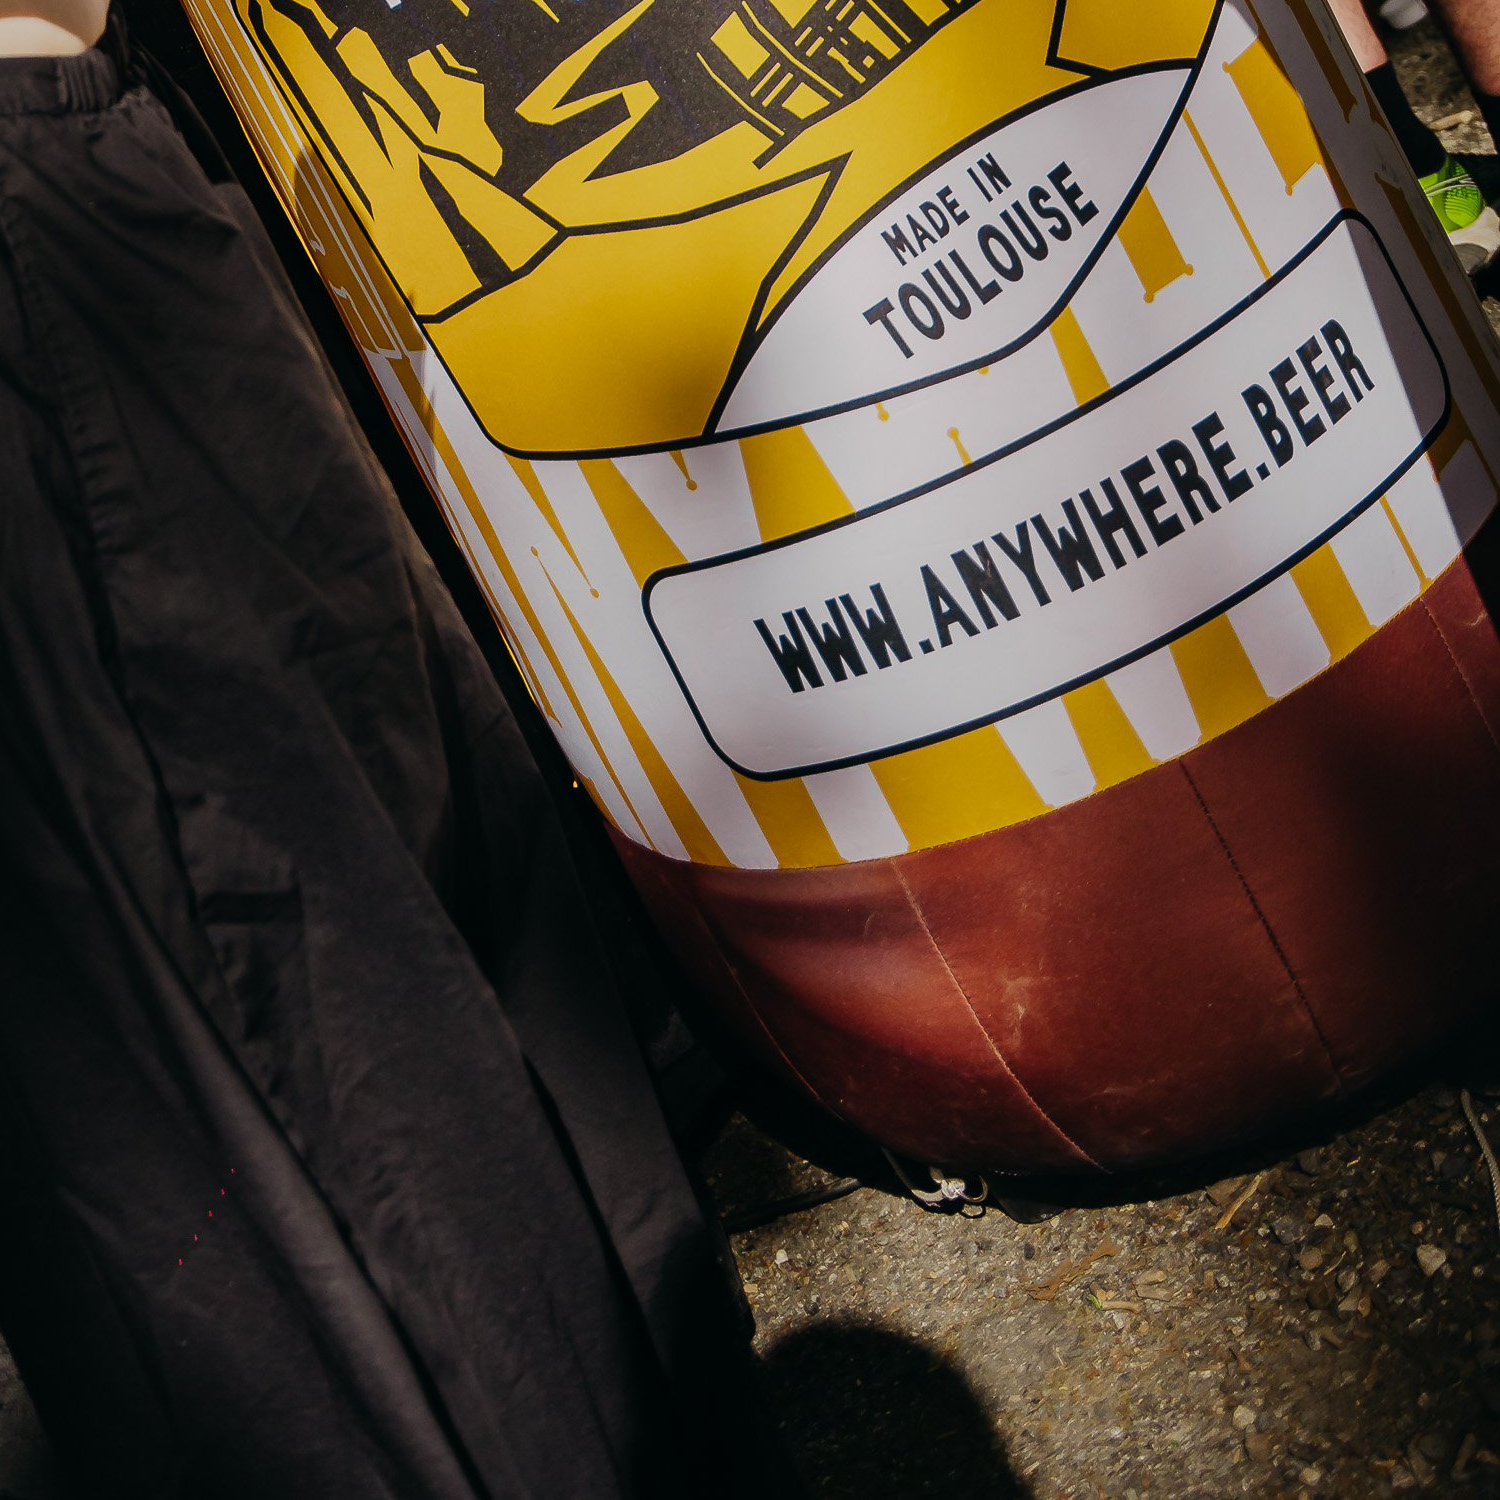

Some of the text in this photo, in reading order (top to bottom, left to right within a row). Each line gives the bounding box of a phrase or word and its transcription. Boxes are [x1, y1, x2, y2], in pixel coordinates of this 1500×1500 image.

[862, 160, 1101, 359] TOULOUSE
[881, 152, 1013, 267] MADE IN
[753, 319, 1376, 694] WWW.ANYWHERE.BEER
